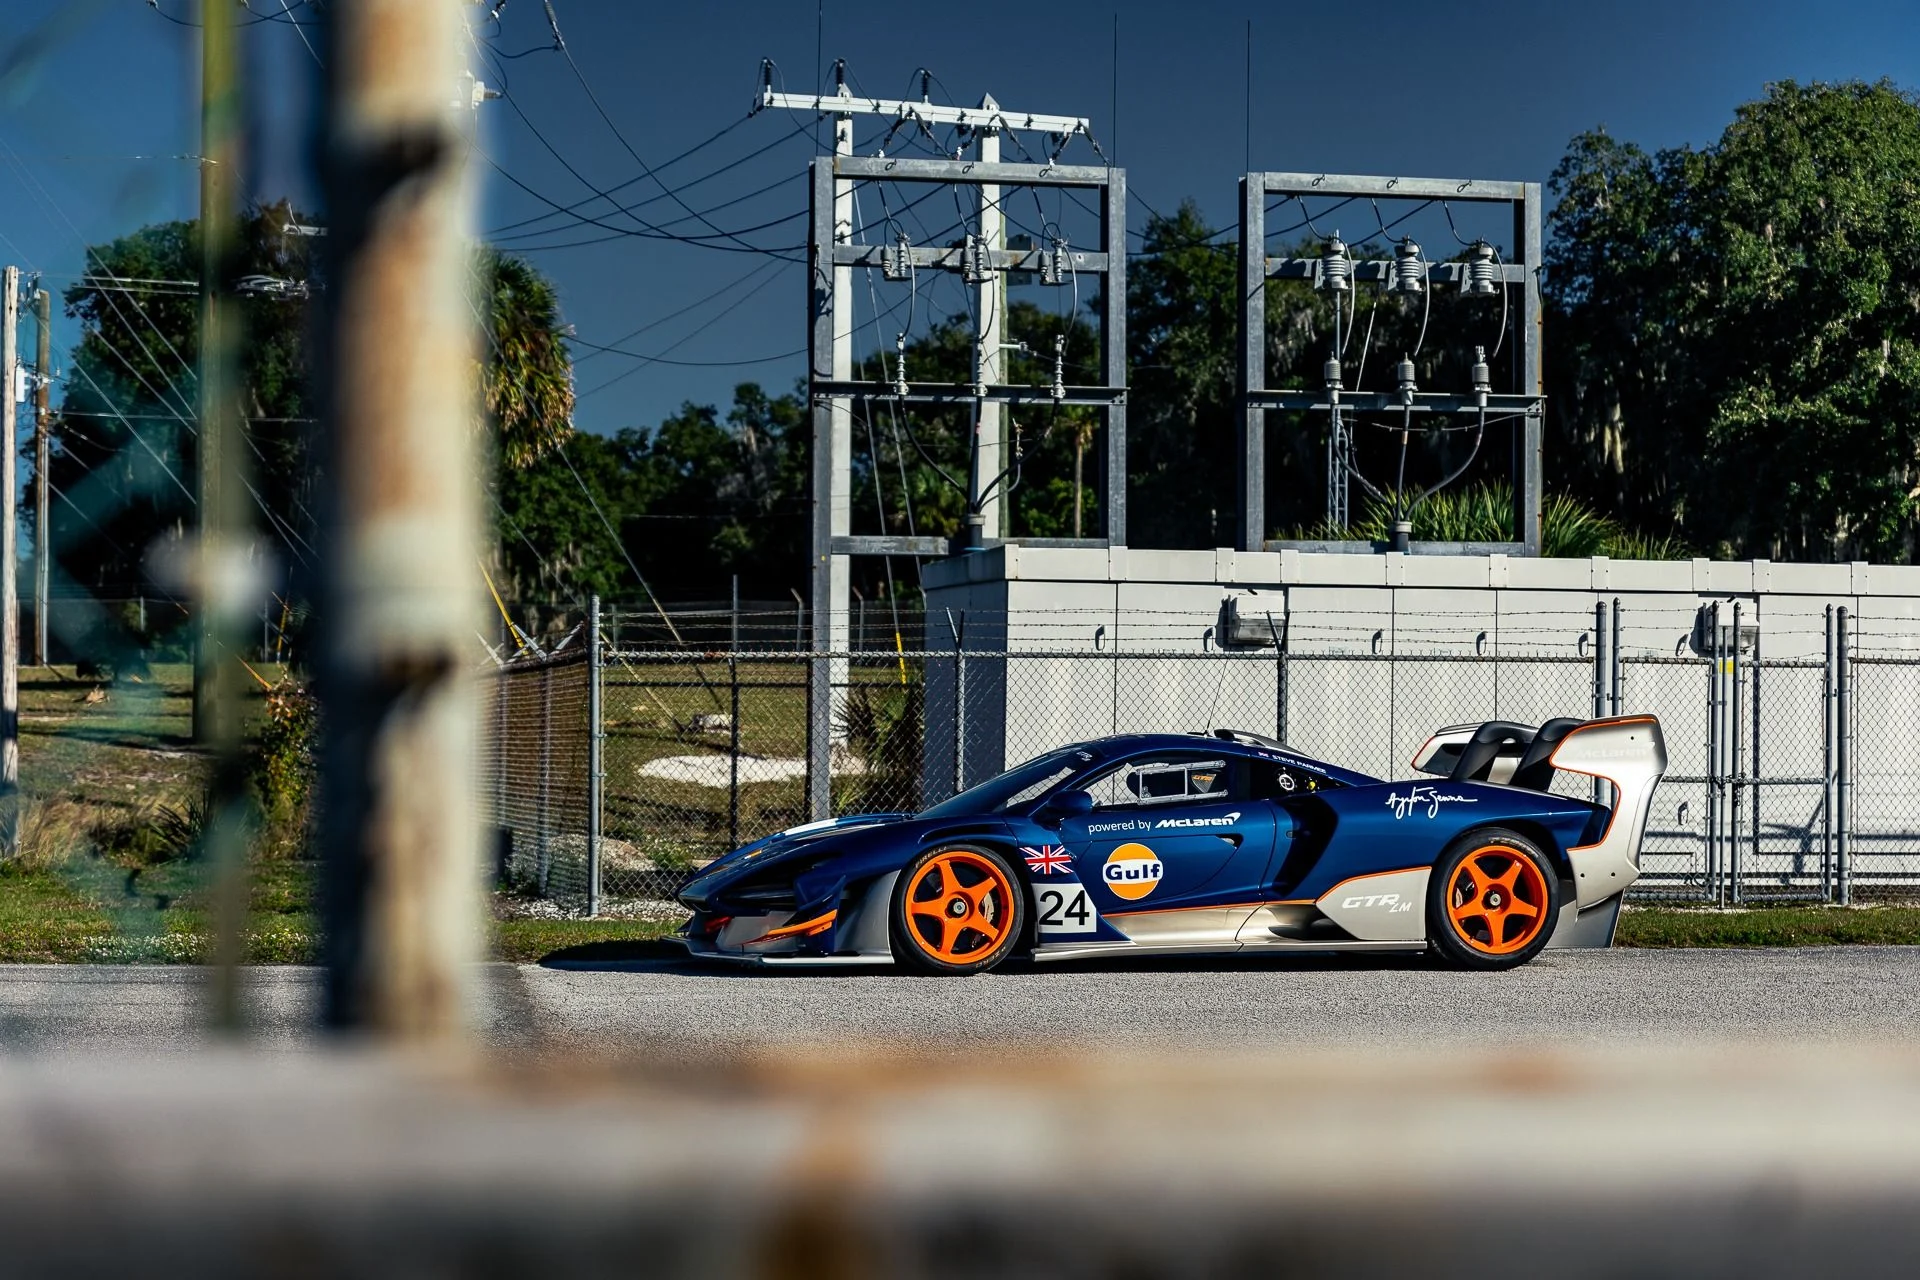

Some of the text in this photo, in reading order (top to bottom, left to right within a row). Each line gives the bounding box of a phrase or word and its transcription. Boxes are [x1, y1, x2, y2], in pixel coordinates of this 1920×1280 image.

[1088, 812, 1241, 835] powered by McLaren
[1105, 864, 1160, 881] Gulf
[1039, 890, 1089, 926] 24
[1342, 893, 1412, 913] GTR LM
